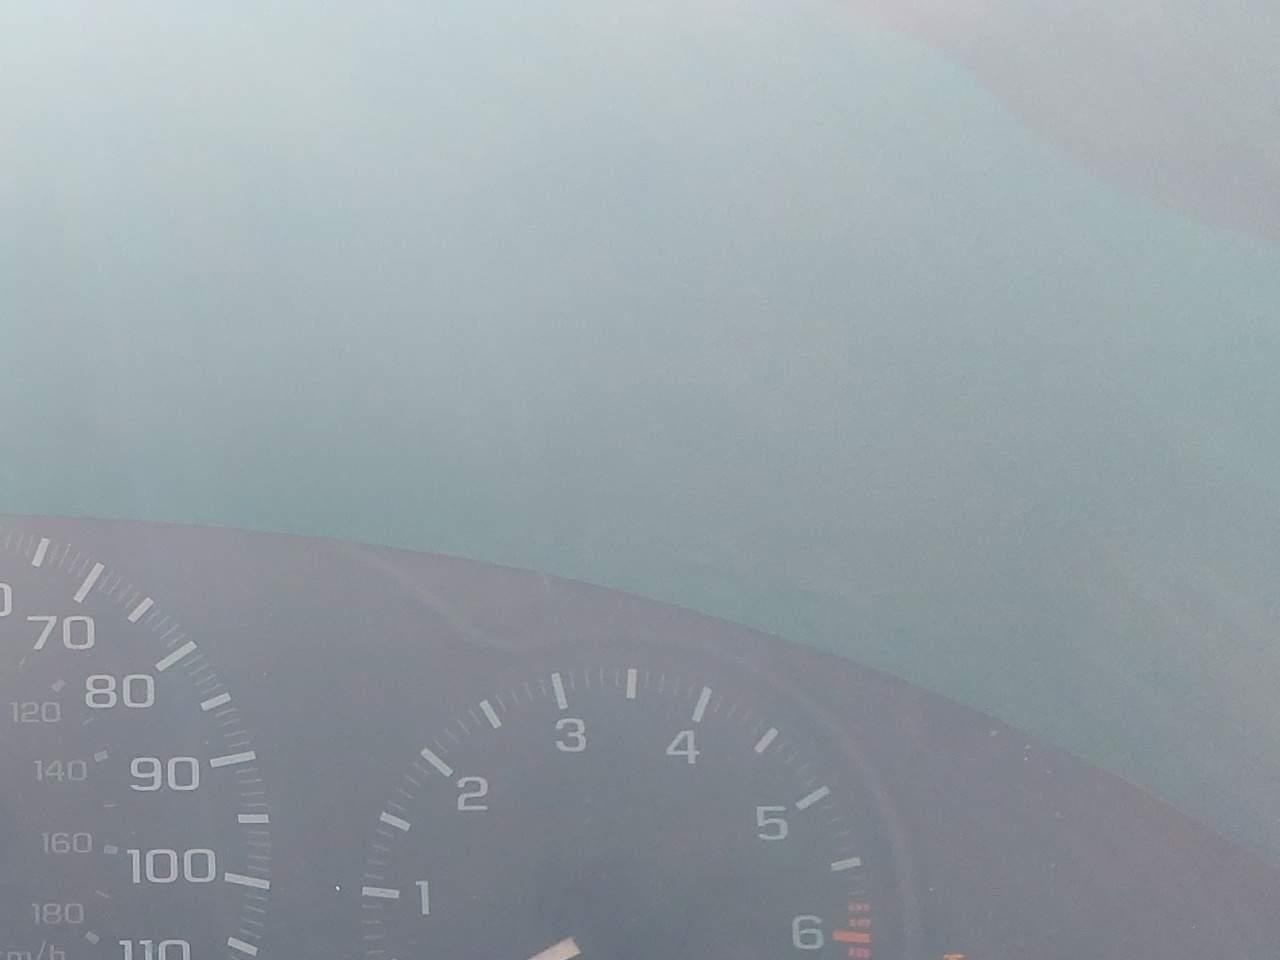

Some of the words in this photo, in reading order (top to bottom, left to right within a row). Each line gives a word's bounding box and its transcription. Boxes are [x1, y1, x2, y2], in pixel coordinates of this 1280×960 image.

[26, 615, 96, 650] 70
[84, 674, 155, 709] 80
[10, 702, 61, 723] 120
[555, 718, 587, 752] 3
[665, 730, 700, 764] 4
[34, 760, 87, 782] 140
[130, 756, 200, 791] 90
[457, 776, 488, 811] 2
[755, 806, 789, 840] 5
[42, 832, 93, 854] 160
[127, 848, 216, 883] 100
[31, 903, 84, 925] 180
[415, 880, 430, 915] 1
[791, 915, 824, 950] 6
